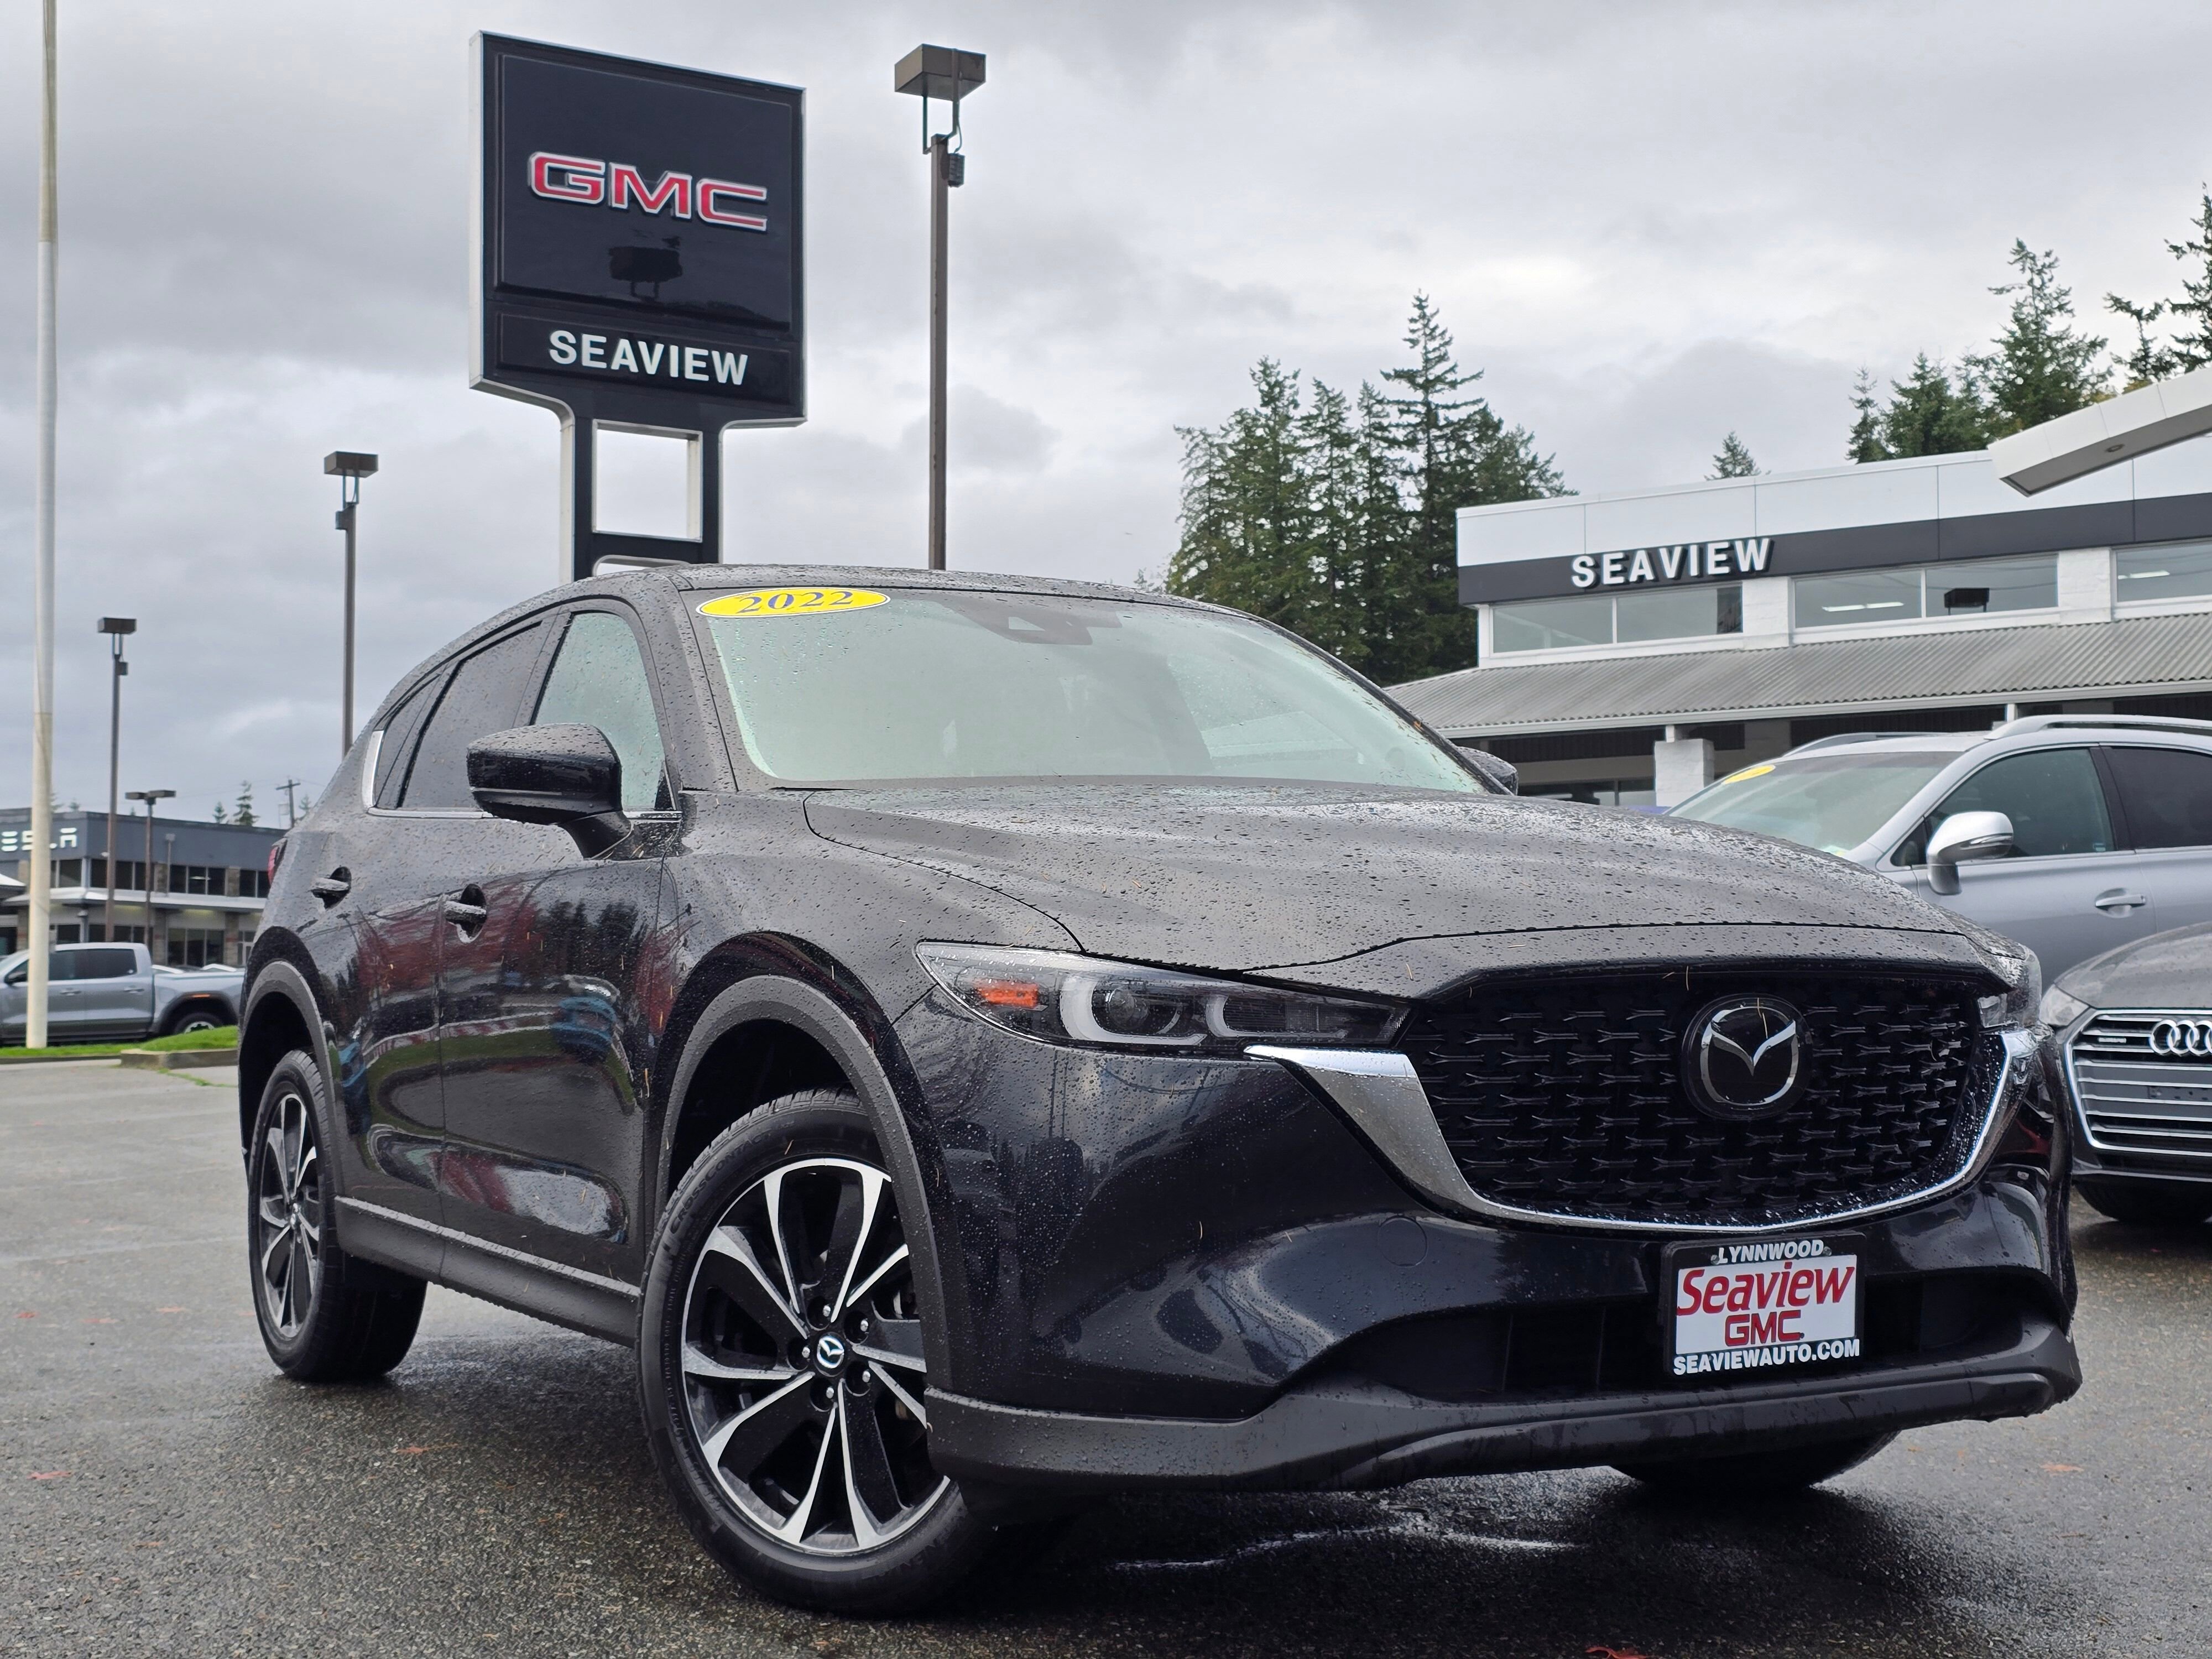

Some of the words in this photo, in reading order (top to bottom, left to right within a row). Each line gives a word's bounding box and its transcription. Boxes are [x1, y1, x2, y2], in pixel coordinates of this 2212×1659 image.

[529, 151, 768, 232] GMC
[549, 330, 748, 385] SEAVIEW
[1571, 538, 1770, 588] SEAVIEW
[735, 591, 854, 614] 2022
[1, 827, 77, 851] ESA
[1718, 1239, 1824, 1264] LYNNWOOD
[1676, 1261, 1855, 1316] Seaview
[1725, 1310, 1802, 1347] GMC
[1673, 1338, 1860, 1375] SEAVIEWAUTO.COM
